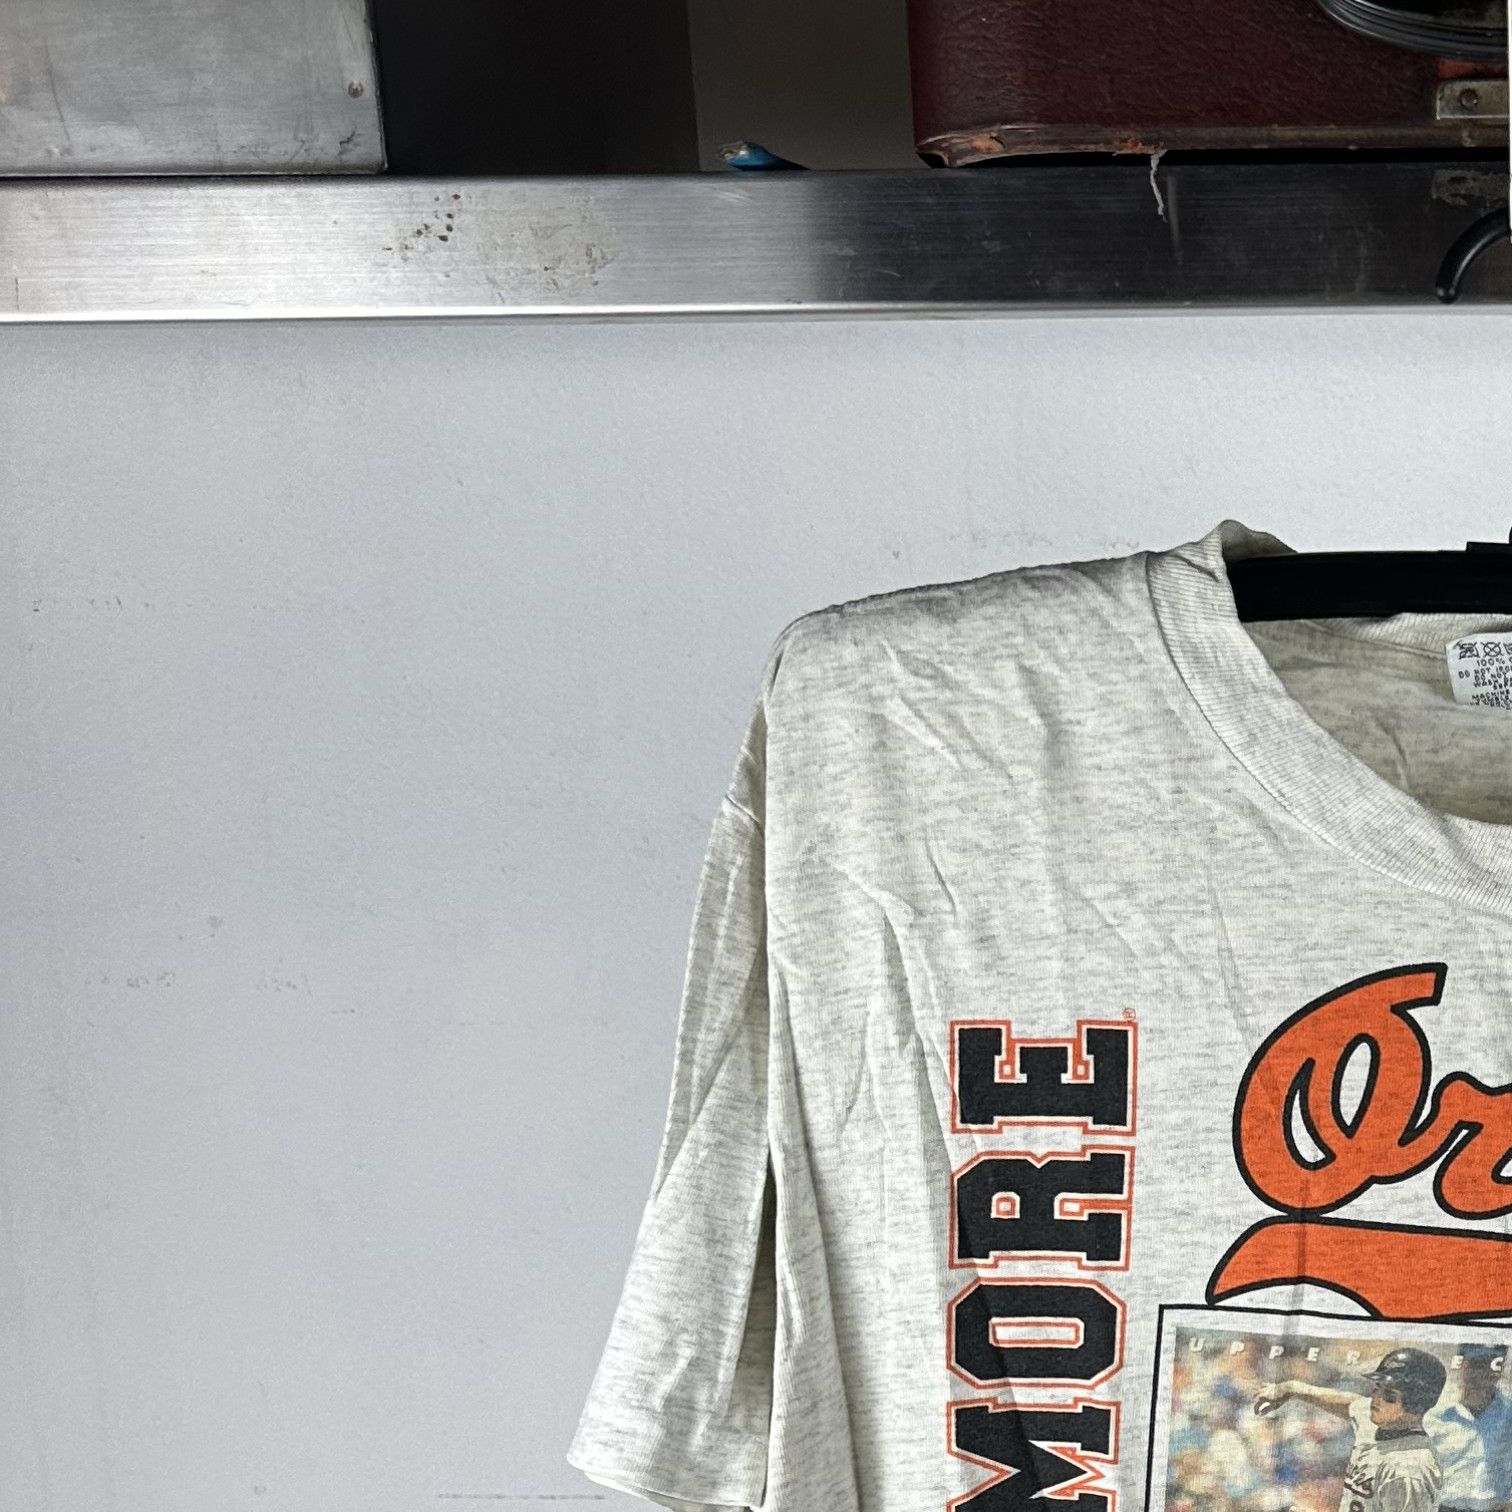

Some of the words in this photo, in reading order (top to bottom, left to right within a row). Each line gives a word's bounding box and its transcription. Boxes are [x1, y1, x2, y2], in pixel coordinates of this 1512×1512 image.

[1476, 656, 1506, 667] 100%
[1458, 670, 1471, 679] DO
[1474, 667, 1491, 675] NOT
[1188, 1336, 1362, 1366] UPPER
